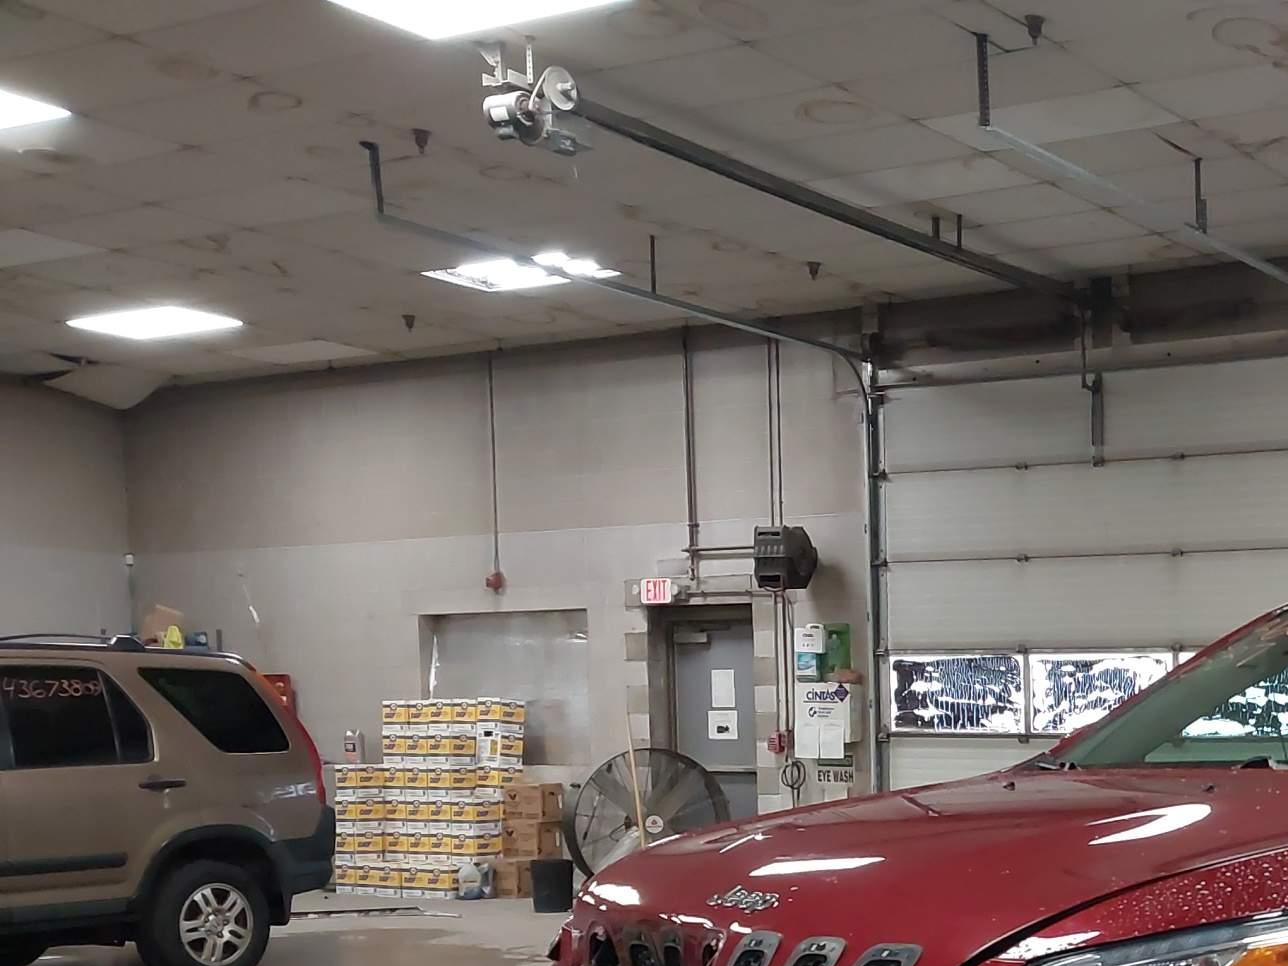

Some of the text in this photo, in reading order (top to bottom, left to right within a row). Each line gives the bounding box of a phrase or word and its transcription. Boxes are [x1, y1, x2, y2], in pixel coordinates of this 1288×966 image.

[646, 580, 667, 601] EXIT
[817, 769, 854, 783] EYE WASH
